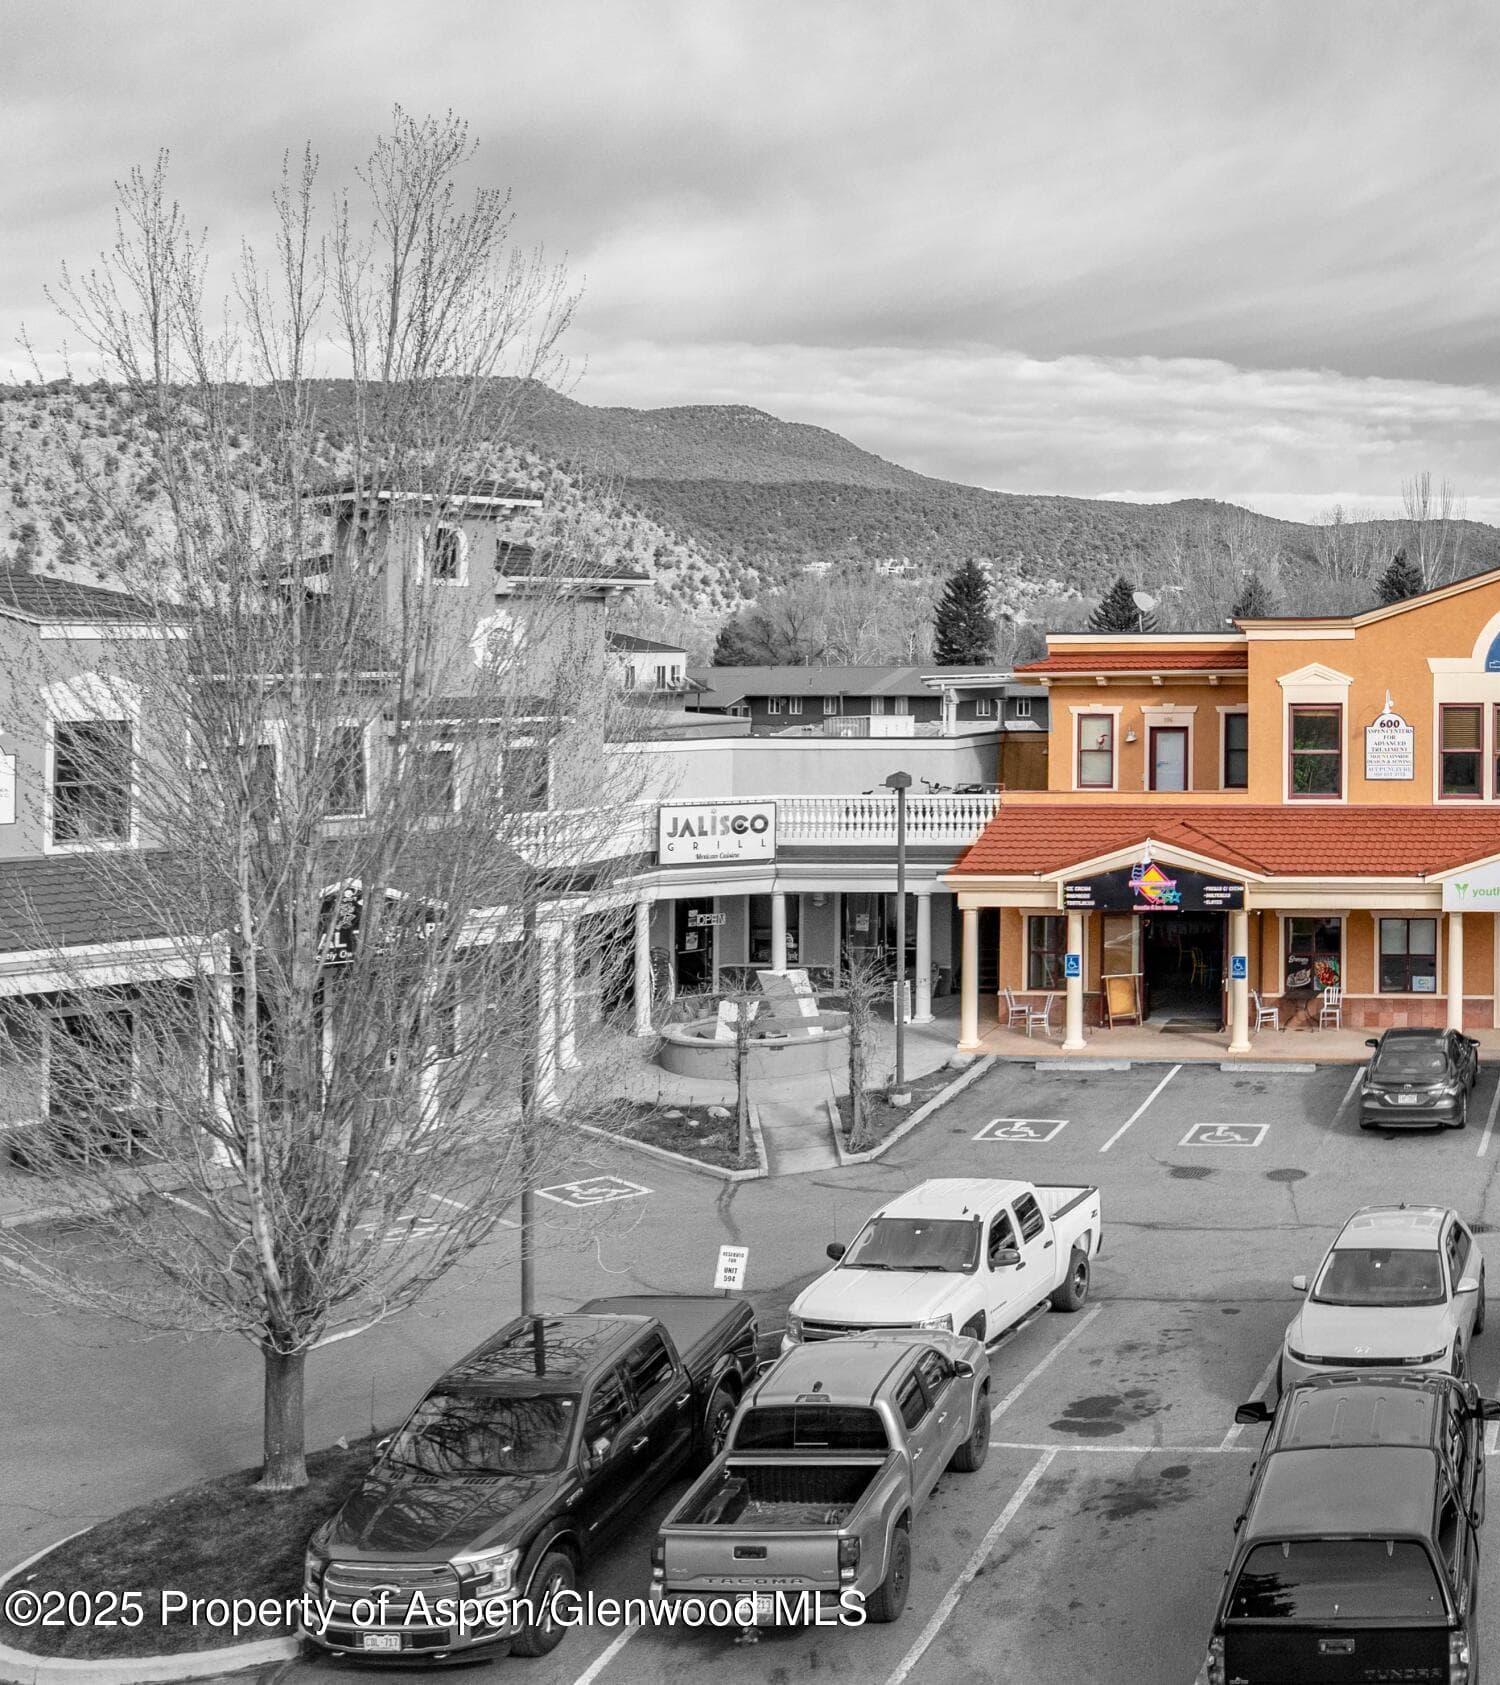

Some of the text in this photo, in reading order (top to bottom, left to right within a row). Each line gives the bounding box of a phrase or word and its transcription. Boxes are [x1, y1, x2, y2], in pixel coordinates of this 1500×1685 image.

[1380, 719, 1400, 728] 600
[667, 838, 766, 852] GRILL
[698, 914, 725, 925] OPEN
[703, 1577, 804, 1585] TACOMA
[1364, 1667, 1443, 1680] TUNDRA
